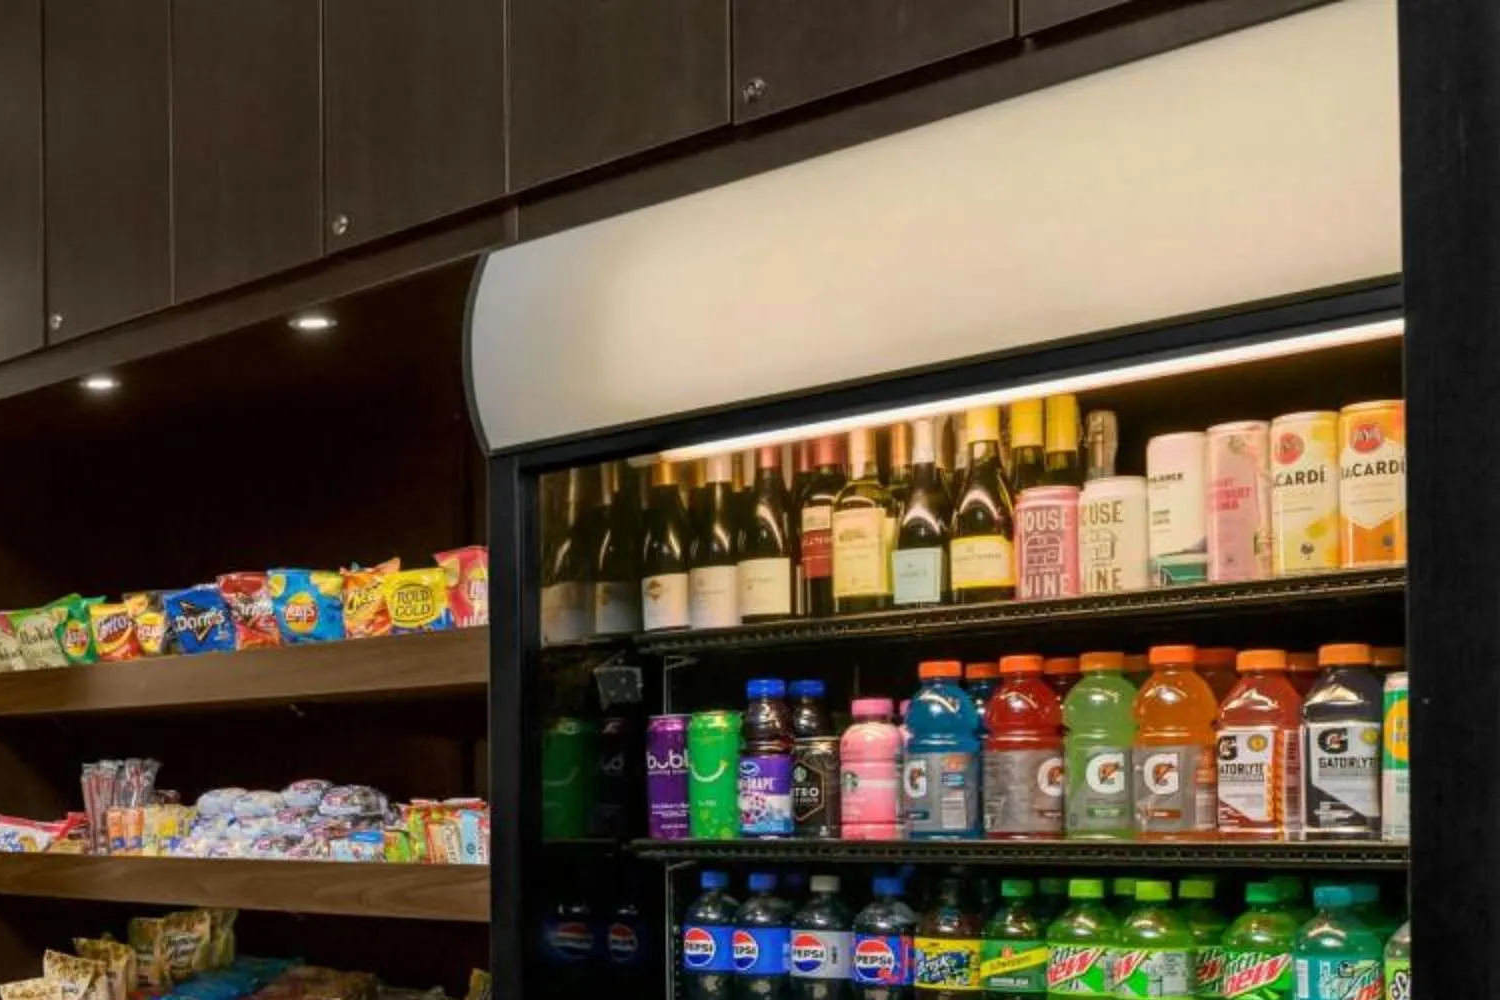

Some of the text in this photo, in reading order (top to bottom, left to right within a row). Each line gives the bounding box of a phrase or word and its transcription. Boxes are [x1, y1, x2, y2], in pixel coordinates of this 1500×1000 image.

[1274, 464, 1327, 487] CARDÍ
[176, 608, 225, 631] Doritos
[395, 603, 431, 617] GOLD
[904, 759, 927, 797] G
[1086, 753, 1125, 794] G
[1143, 753, 1180, 795] G
[857, 954, 894, 965] PEPSI
